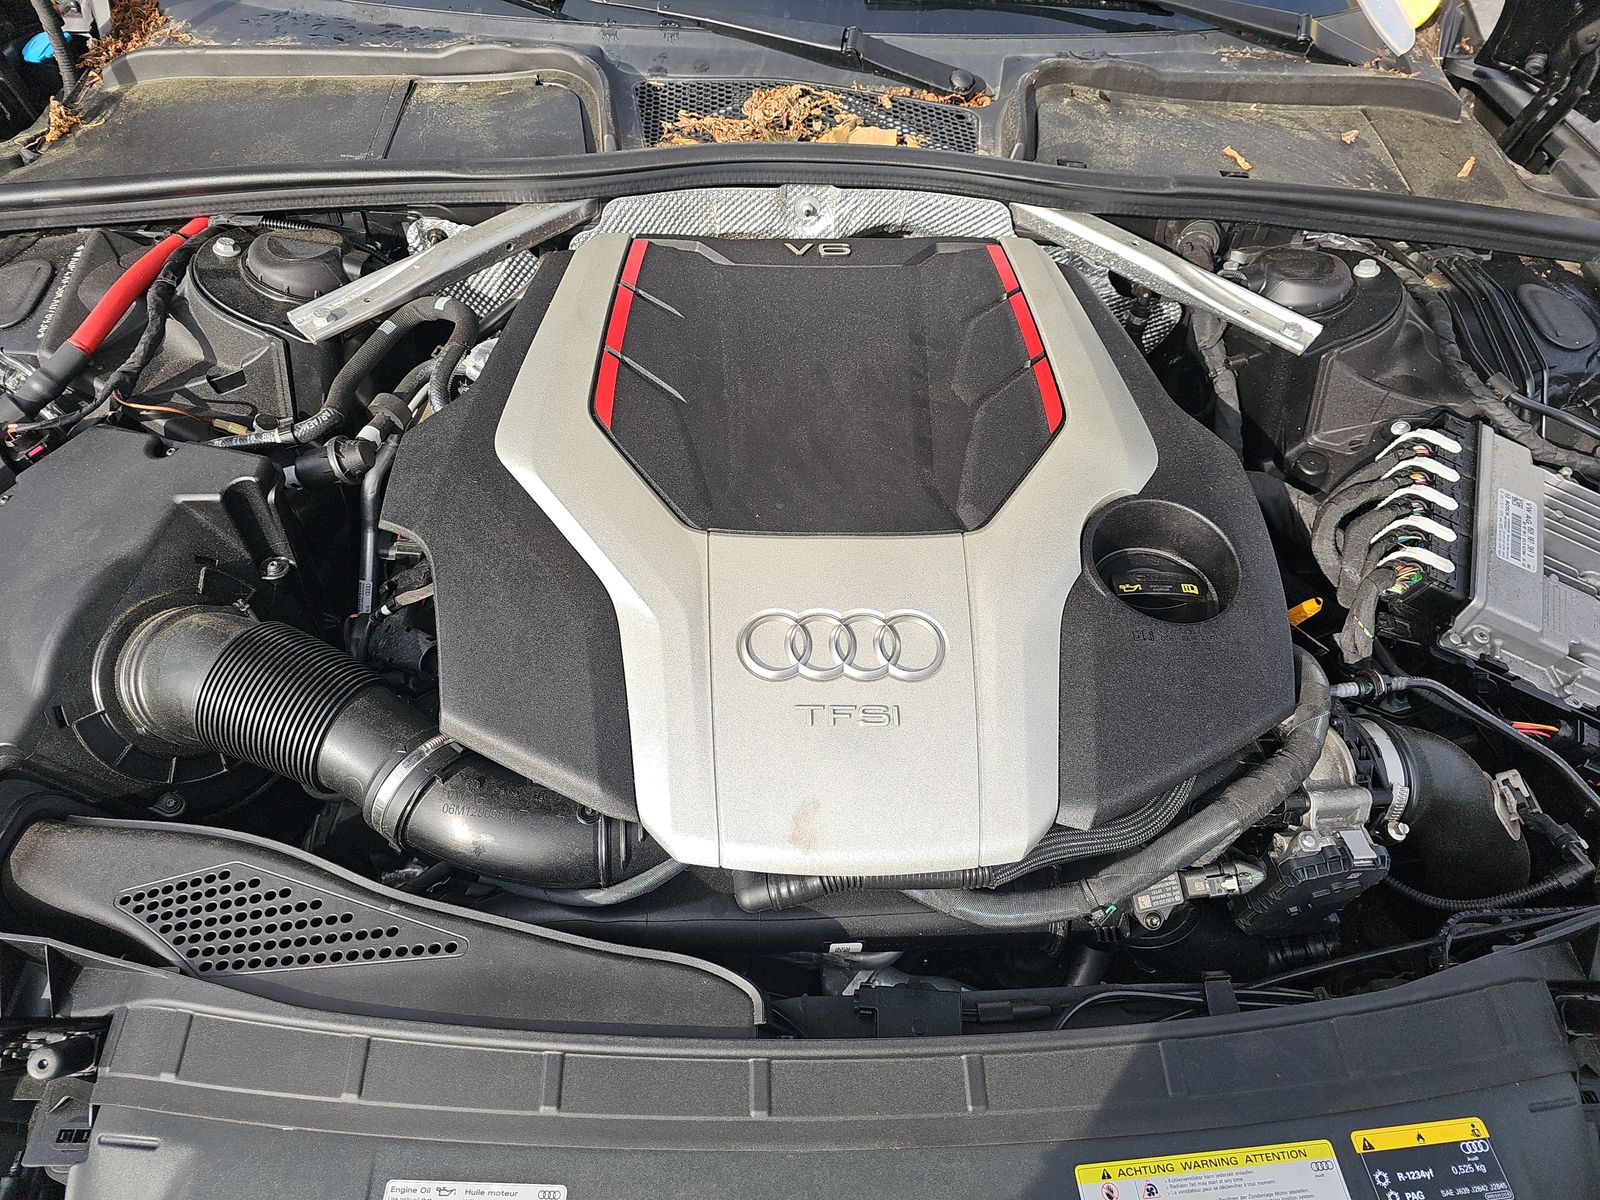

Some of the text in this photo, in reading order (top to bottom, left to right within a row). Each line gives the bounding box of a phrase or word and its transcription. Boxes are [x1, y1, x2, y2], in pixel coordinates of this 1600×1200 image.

[784, 243, 851, 258] V6
[795, 704, 900, 727] TFSI
[1117, 1149, 1308, 1178] ACHTUNG WARNING ATTENTION
[1451, 1163, 1487, 1175] 0,525 kg
[1396, 1168, 1435, 1181] R-1234yf
[390, 1186, 417, 1195] Engine
[464, 1188, 485, 1196] Huile
[1404, 1190, 1425, 1200] PAG
[1440, 1188, 1455, 1197] SAE
